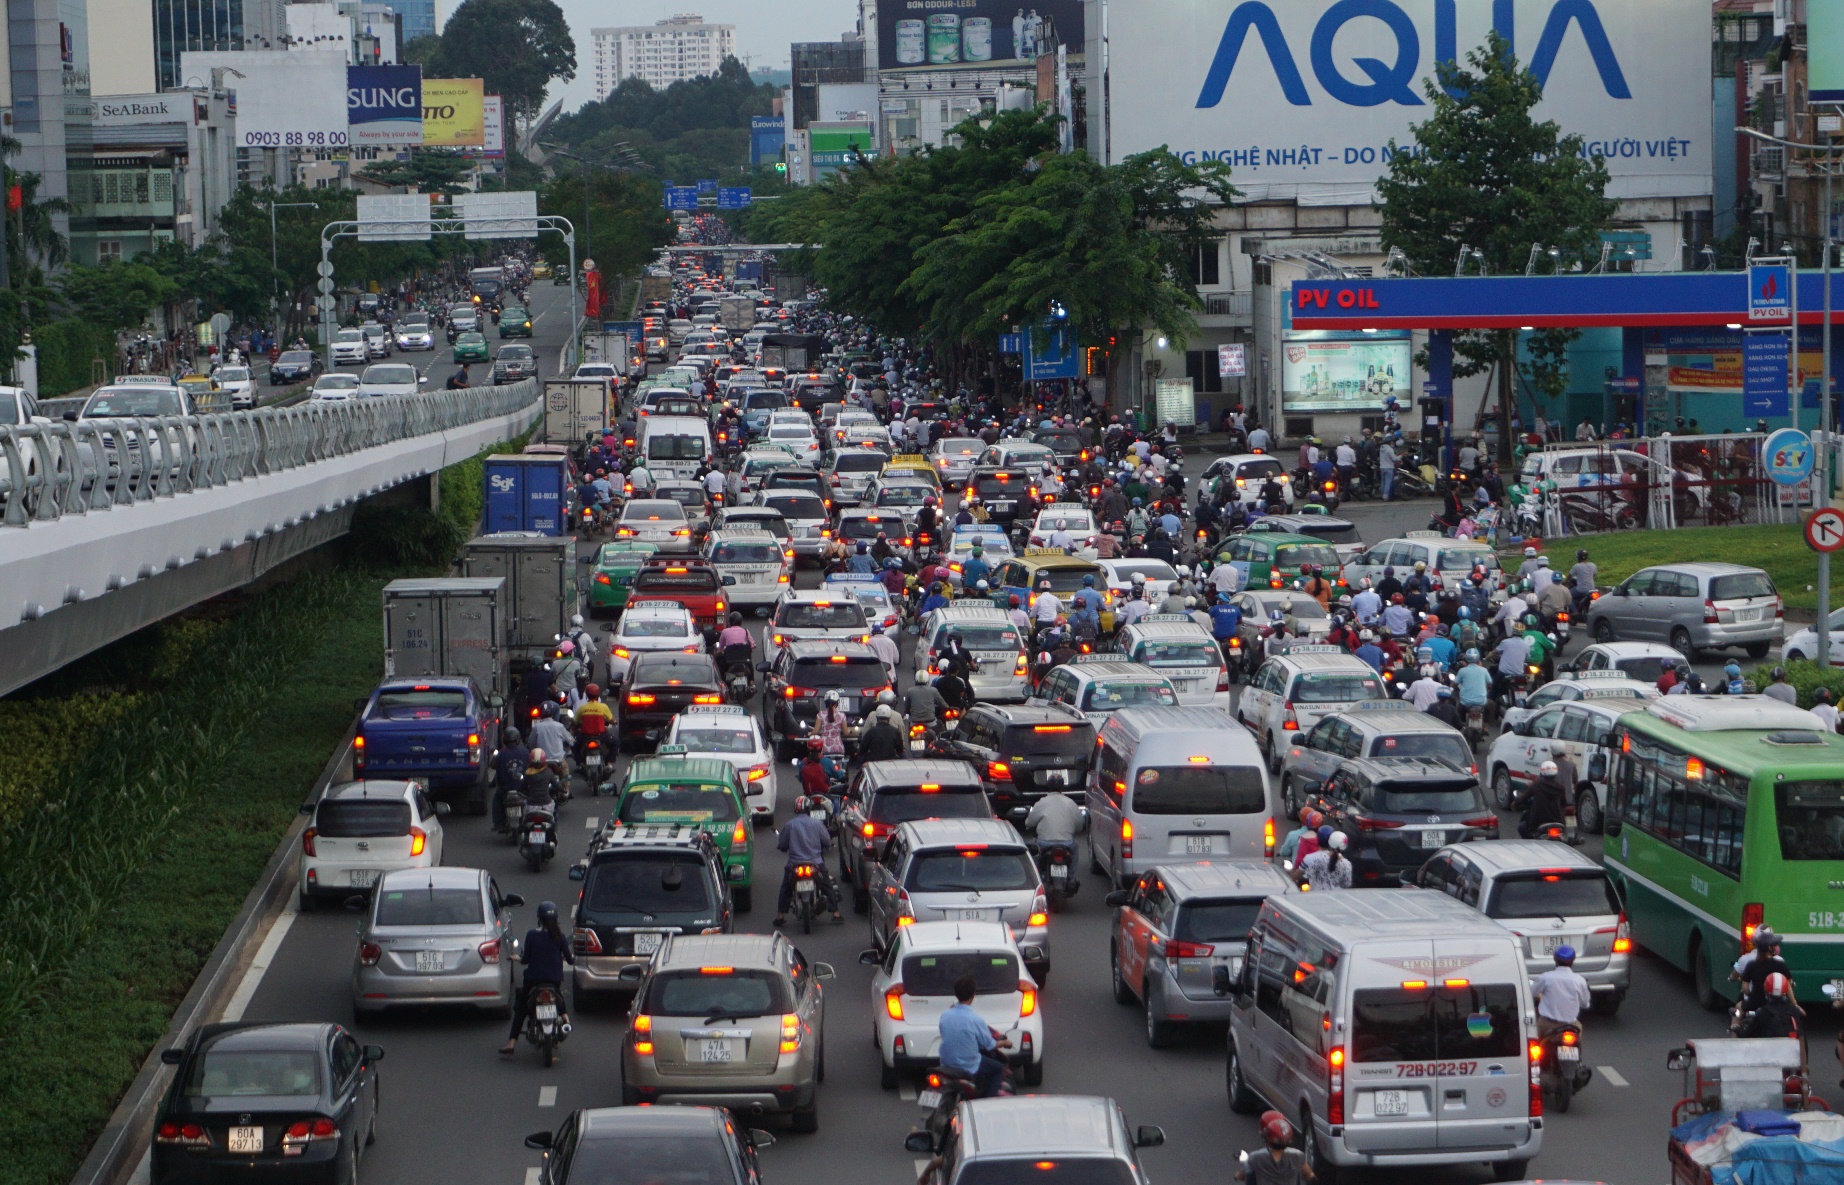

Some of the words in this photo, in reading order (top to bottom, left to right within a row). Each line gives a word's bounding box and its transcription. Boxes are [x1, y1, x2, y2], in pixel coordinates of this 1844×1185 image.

[1194, 0, 1632, 108] AQUA
[347, 87, 415, 109] SUNG
[102, 102, 169, 118] SeABank
[246, 131, 281, 146] 0903
[285, 131, 303, 146] 88
[308, 131, 325, 145] 98
[329, 130, 347, 145] 00
[382, 131, 390, 140] by
[391, 132, 406, 140] your
[1646, 136, 1691, 161] VIỆT
[1266, 144, 1323, 170] NHẬT
[1344, 147, 1375, 165] DO
[1297, 288, 1330, 309] PV
[1336, 288, 1379, 309] OIL
[1753, 308, 1766, 317] PV
[1768, 307, 1785, 316] OIL
[407, 629, 423, 638] 51C
[452, 639, 489, 649] EXPRESS
[1596, 690, 1612, 698] 38.27
[1192, 837, 1206, 845] 61B
[1426, 832, 1440, 840] 60A
[965, 910, 981, 920] 51A
[640, 934, 656, 944] 52U
[1549, 936, 1564, 946] 51A
[1401, 959, 1467, 970] LIMOUSINE
[708, 1040, 725, 1050] 47A
[1382, 1092, 1400, 1103] 72B
[237, 1128, 255, 1139] 60A
[230, 1139, 262, 1150] 297.13
